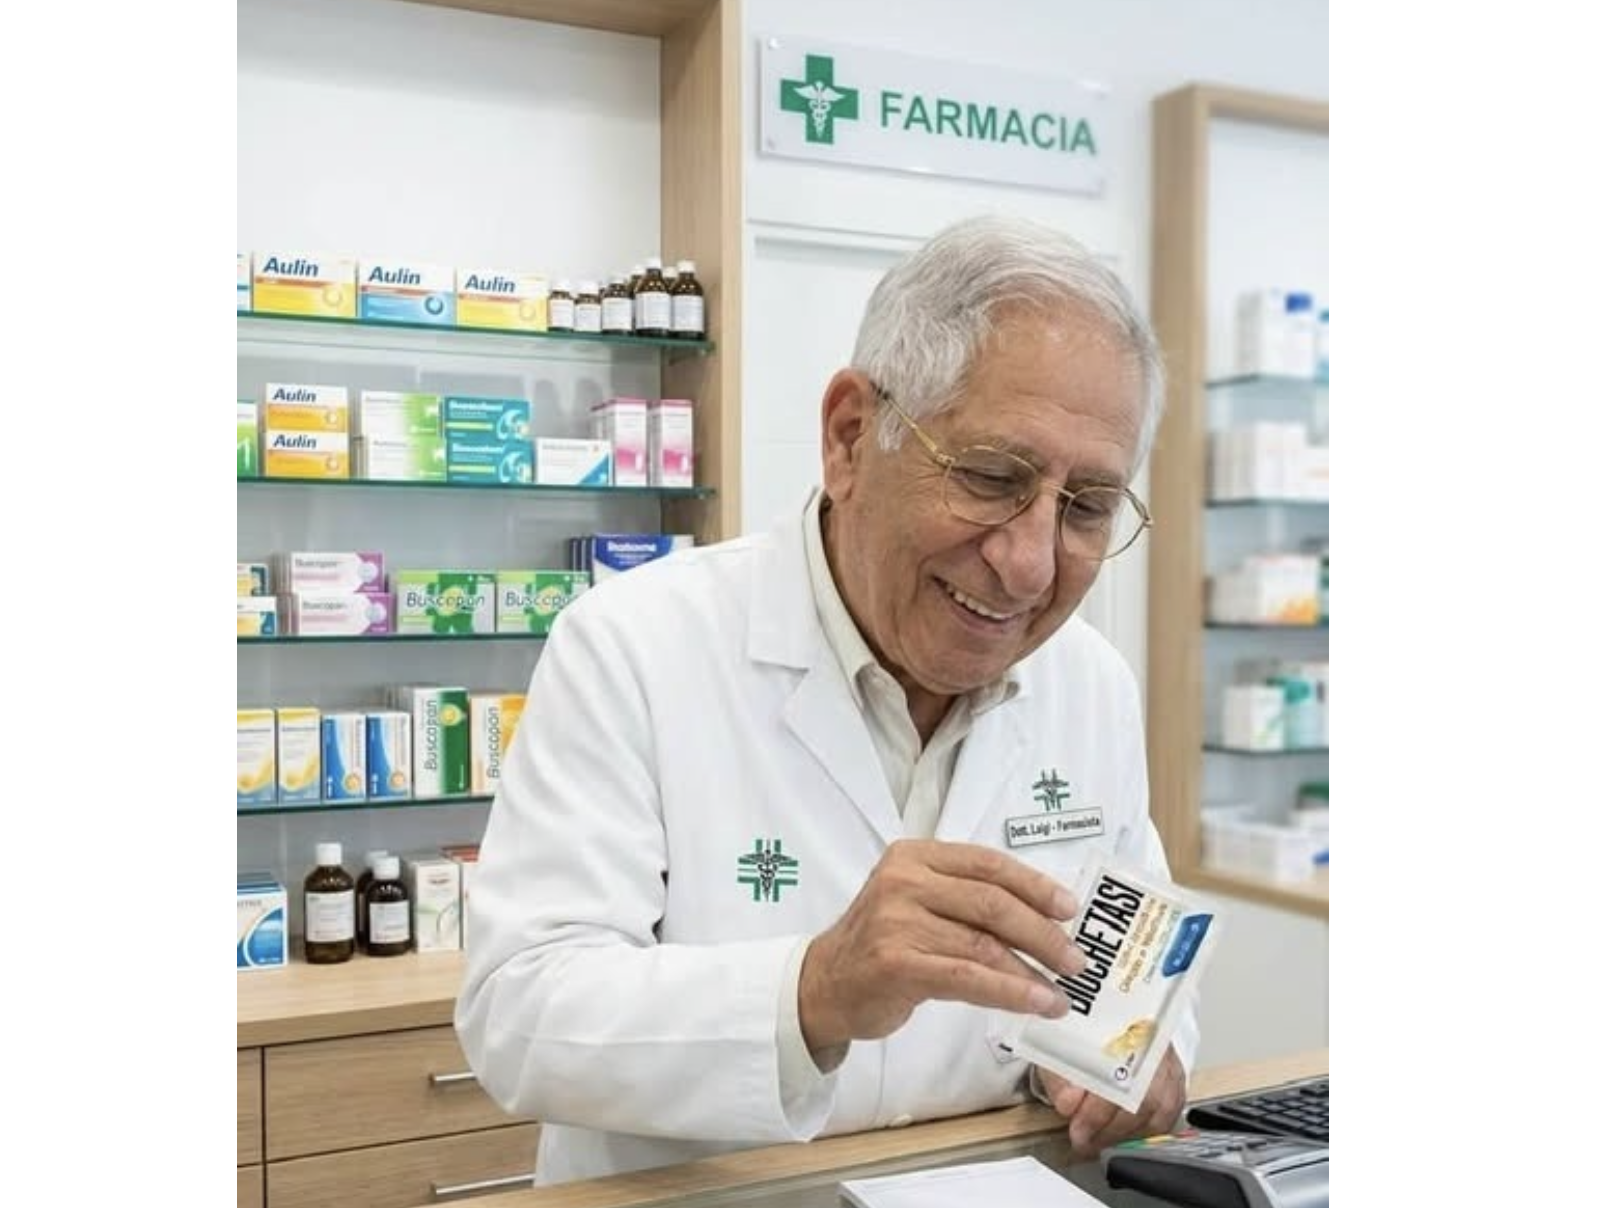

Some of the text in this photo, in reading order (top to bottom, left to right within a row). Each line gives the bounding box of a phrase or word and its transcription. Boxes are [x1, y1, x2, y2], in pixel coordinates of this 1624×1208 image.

[880, 90, 1097, 155] FARMACIA
[263, 256, 319, 278] Aulin
[368, 265, 421, 285] Aulin
[464, 273, 516, 294] Aulin
[272, 387, 317, 403] Aulin
[272, 434, 317, 449] Aulin
